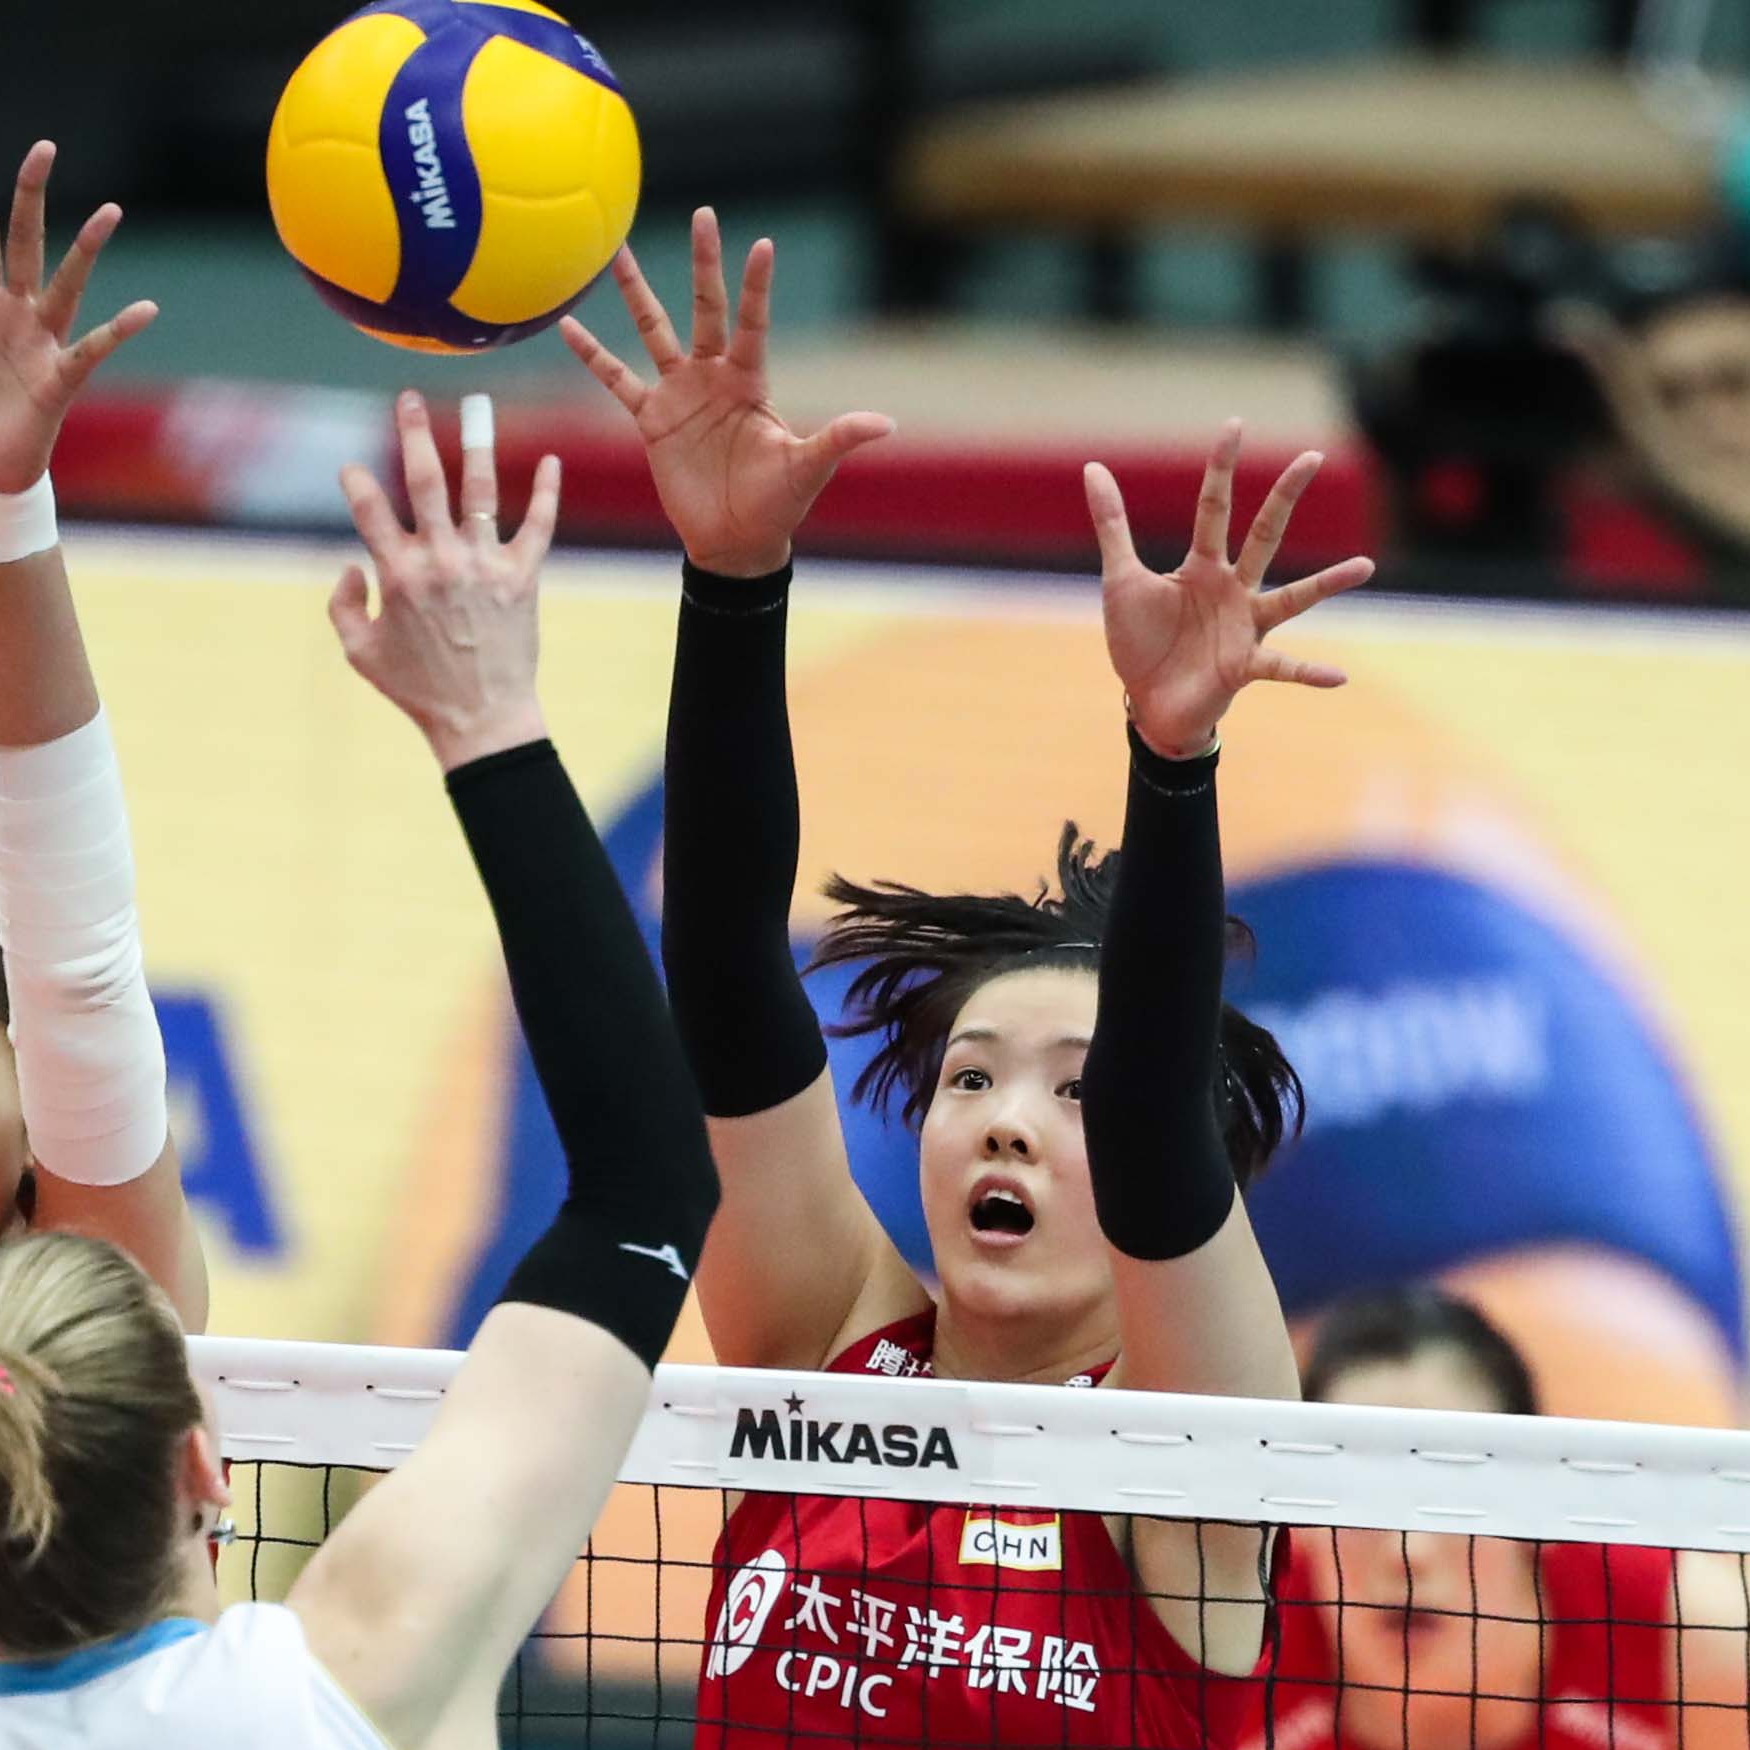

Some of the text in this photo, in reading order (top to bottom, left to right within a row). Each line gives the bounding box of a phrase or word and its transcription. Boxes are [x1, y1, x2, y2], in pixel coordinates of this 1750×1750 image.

[972, 1530, 1050, 1558] CHN
[783, 1574, 1102, 1713] 太平洋保险
[775, 1651, 895, 1718] CPIC
